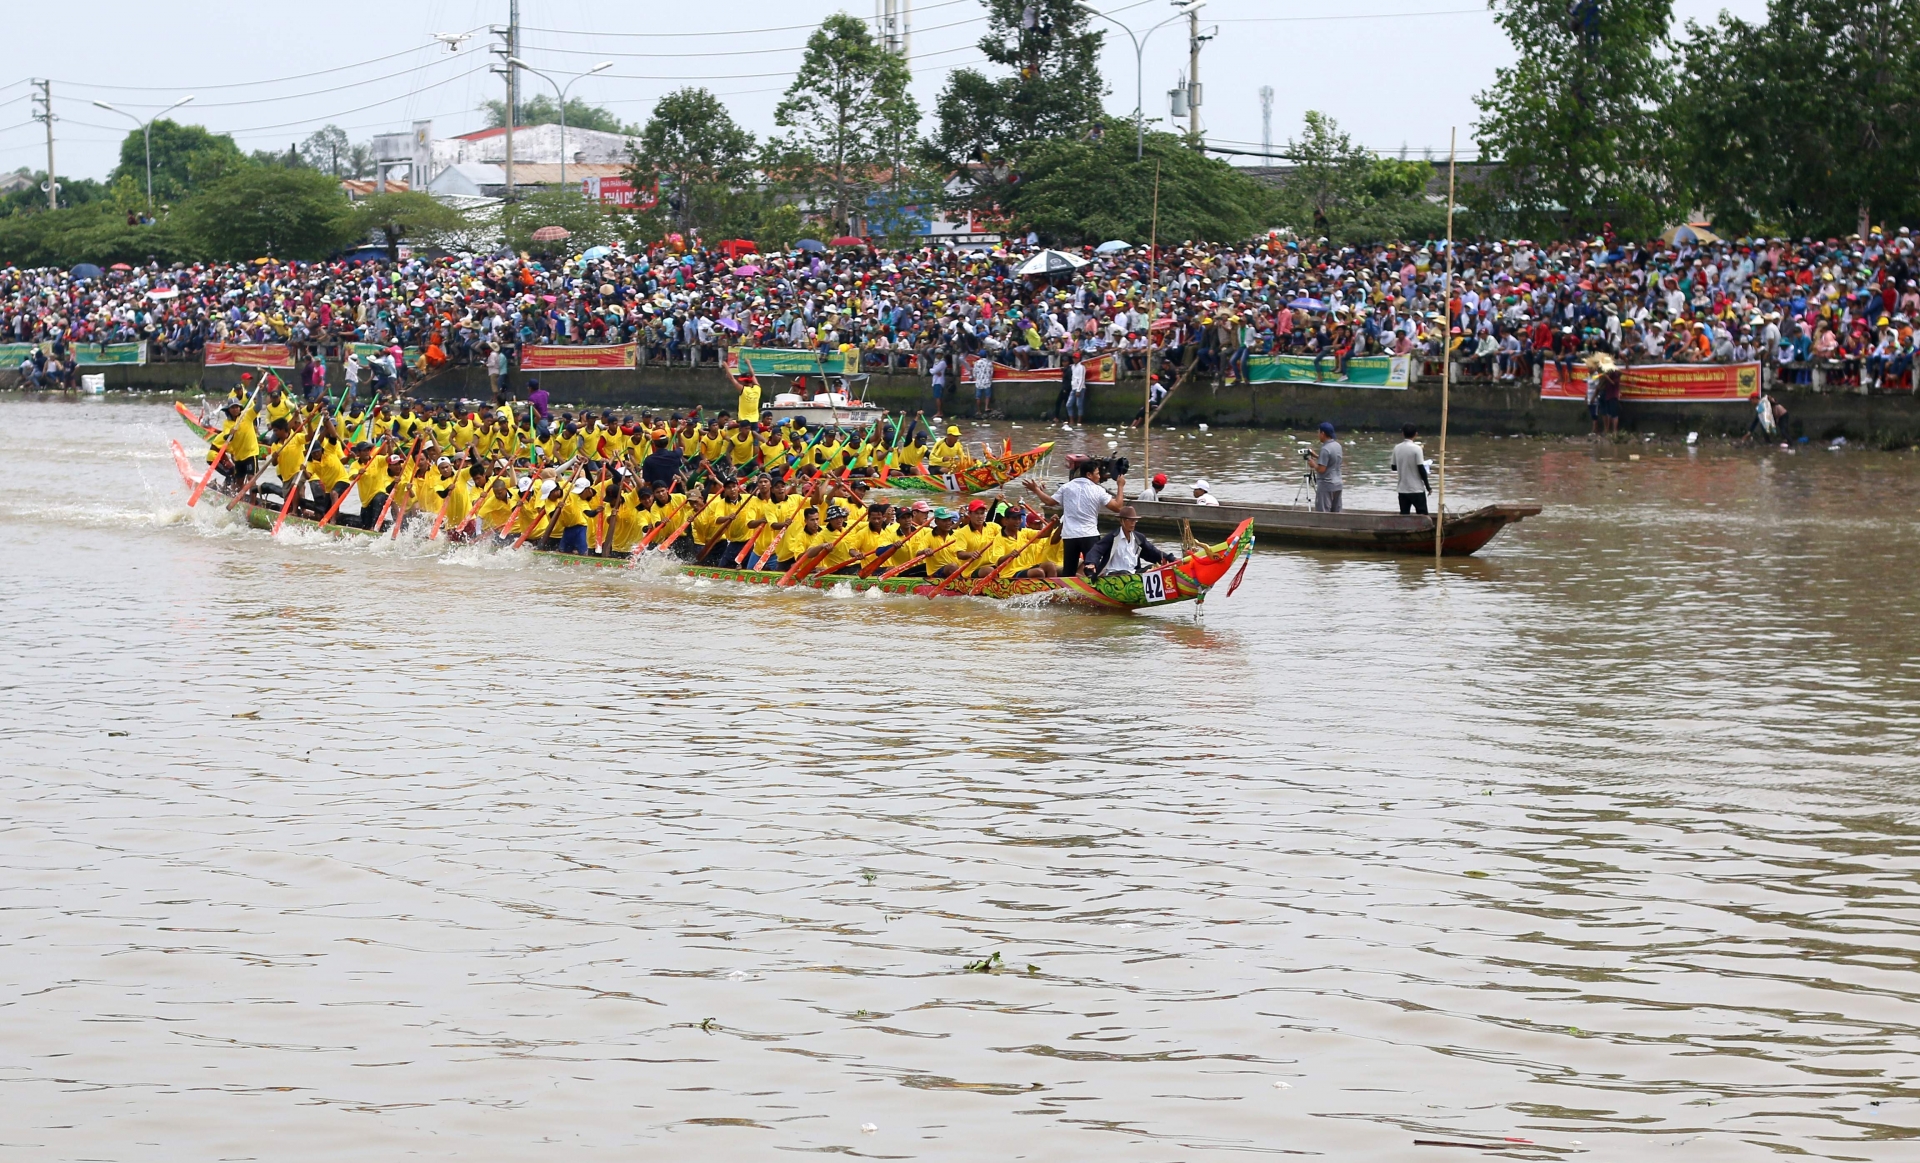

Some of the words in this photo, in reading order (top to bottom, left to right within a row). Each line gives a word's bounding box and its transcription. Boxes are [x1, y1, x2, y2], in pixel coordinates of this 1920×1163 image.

[604, 189, 623, 204] THÁI
[946, 476, 954, 490] 7
[1146, 574, 1162, 598] 42
